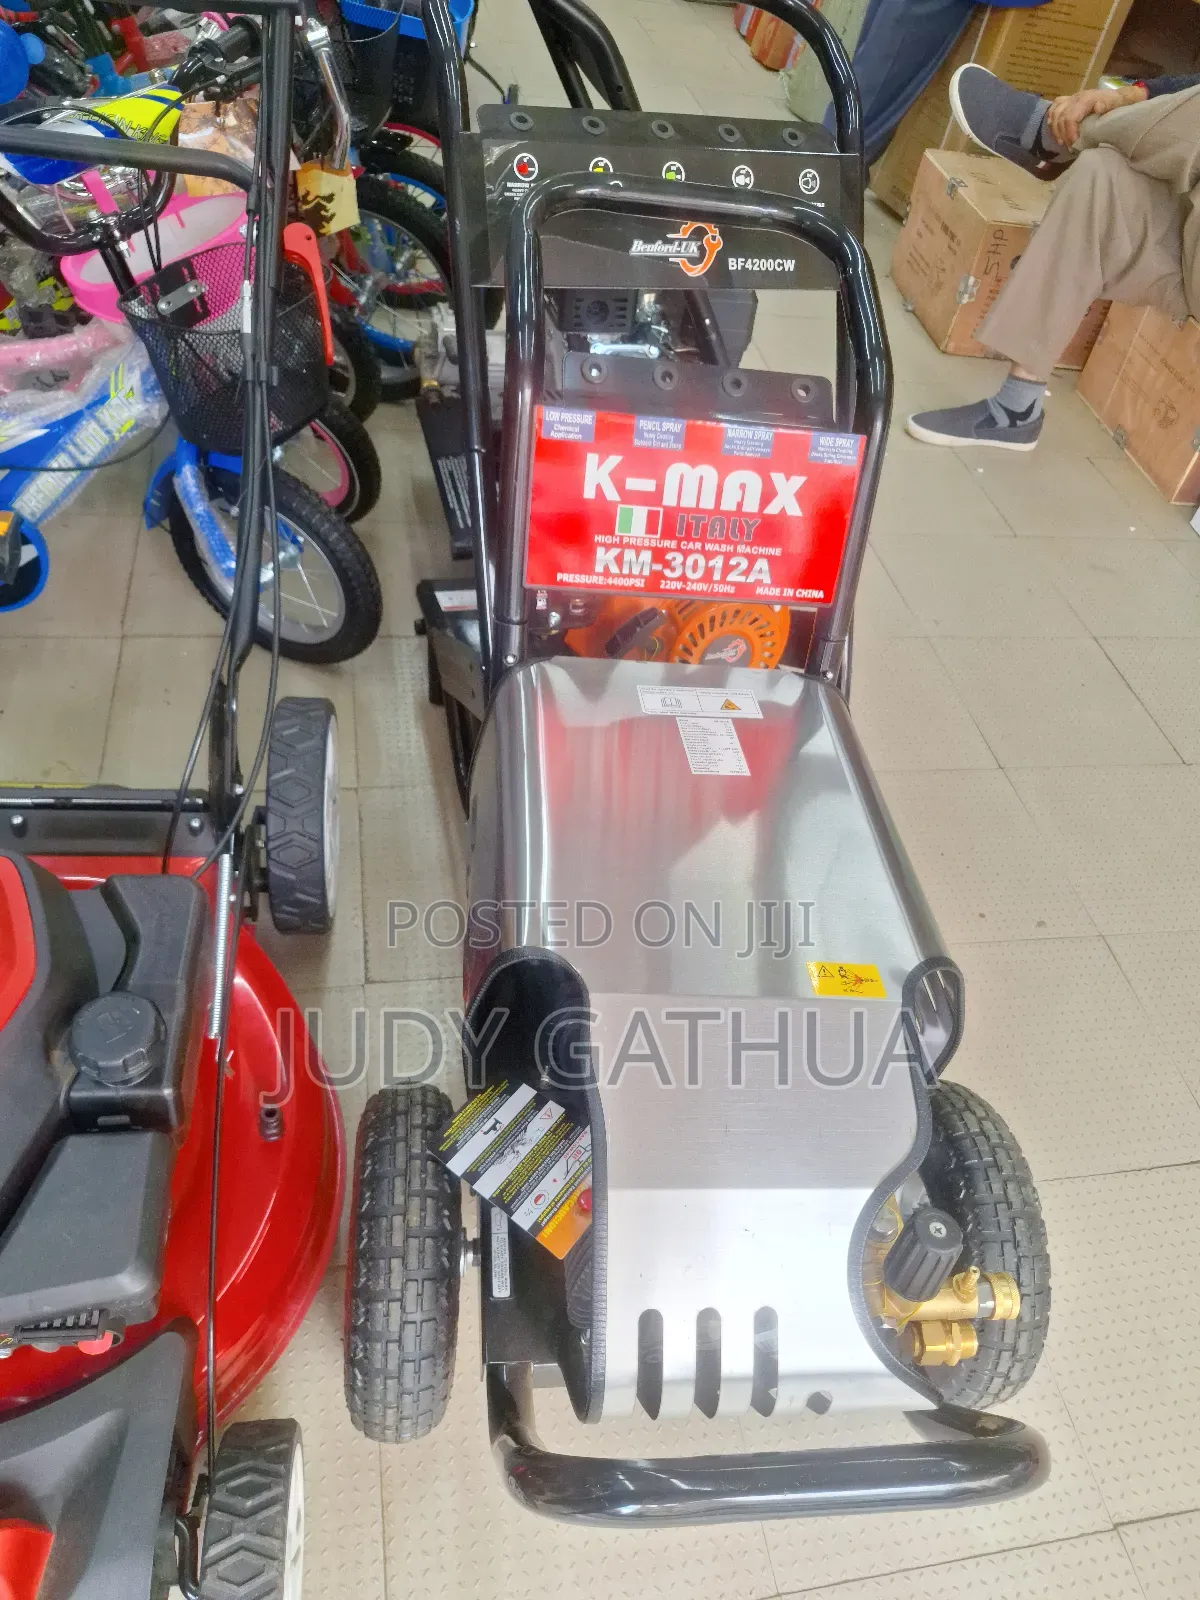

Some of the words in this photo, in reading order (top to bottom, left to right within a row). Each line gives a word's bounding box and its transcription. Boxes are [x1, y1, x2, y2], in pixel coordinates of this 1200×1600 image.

[631, 239, 702, 254] Benford-UK
[728, 258, 795, 271] BF4200CW
[545, 410, 559, 422] LOW
[560, 412, 593, 425] PRESSURE
[553, 423, 580, 433] Chemical
[639, 420, 661, 431] PENCIL
[661, 422, 682, 433] SPRAY
[550, 430, 582, 440] Application
[726, 428, 753, 439] NARROW
[754, 431, 774, 441] SPRAY
[820, 436, 835, 447] WIDE
[835, 438, 855, 448] SPRAY
[583, 453, 807, 517] K-MAX
[675, 513, 761, 542] ITALY
[594, 535, 620, 545] HIGH
[622, 536, 677, 549] PRESSURE
[680, 540, 701, 551] CAR
[704, 543, 734, 553] WASH
[736, 545, 782, 557] MACHINE
[594, 546, 772, 584] KM-3012A
[556, 572, 646, 588] PRESSURE:4400PSI
[659, 580, 736, 595] 220V-240V/50Hz
[756, 586, 781, 597] MADE
[783, 587, 794, 598] IN
[795, 588, 825, 599] CHINA
